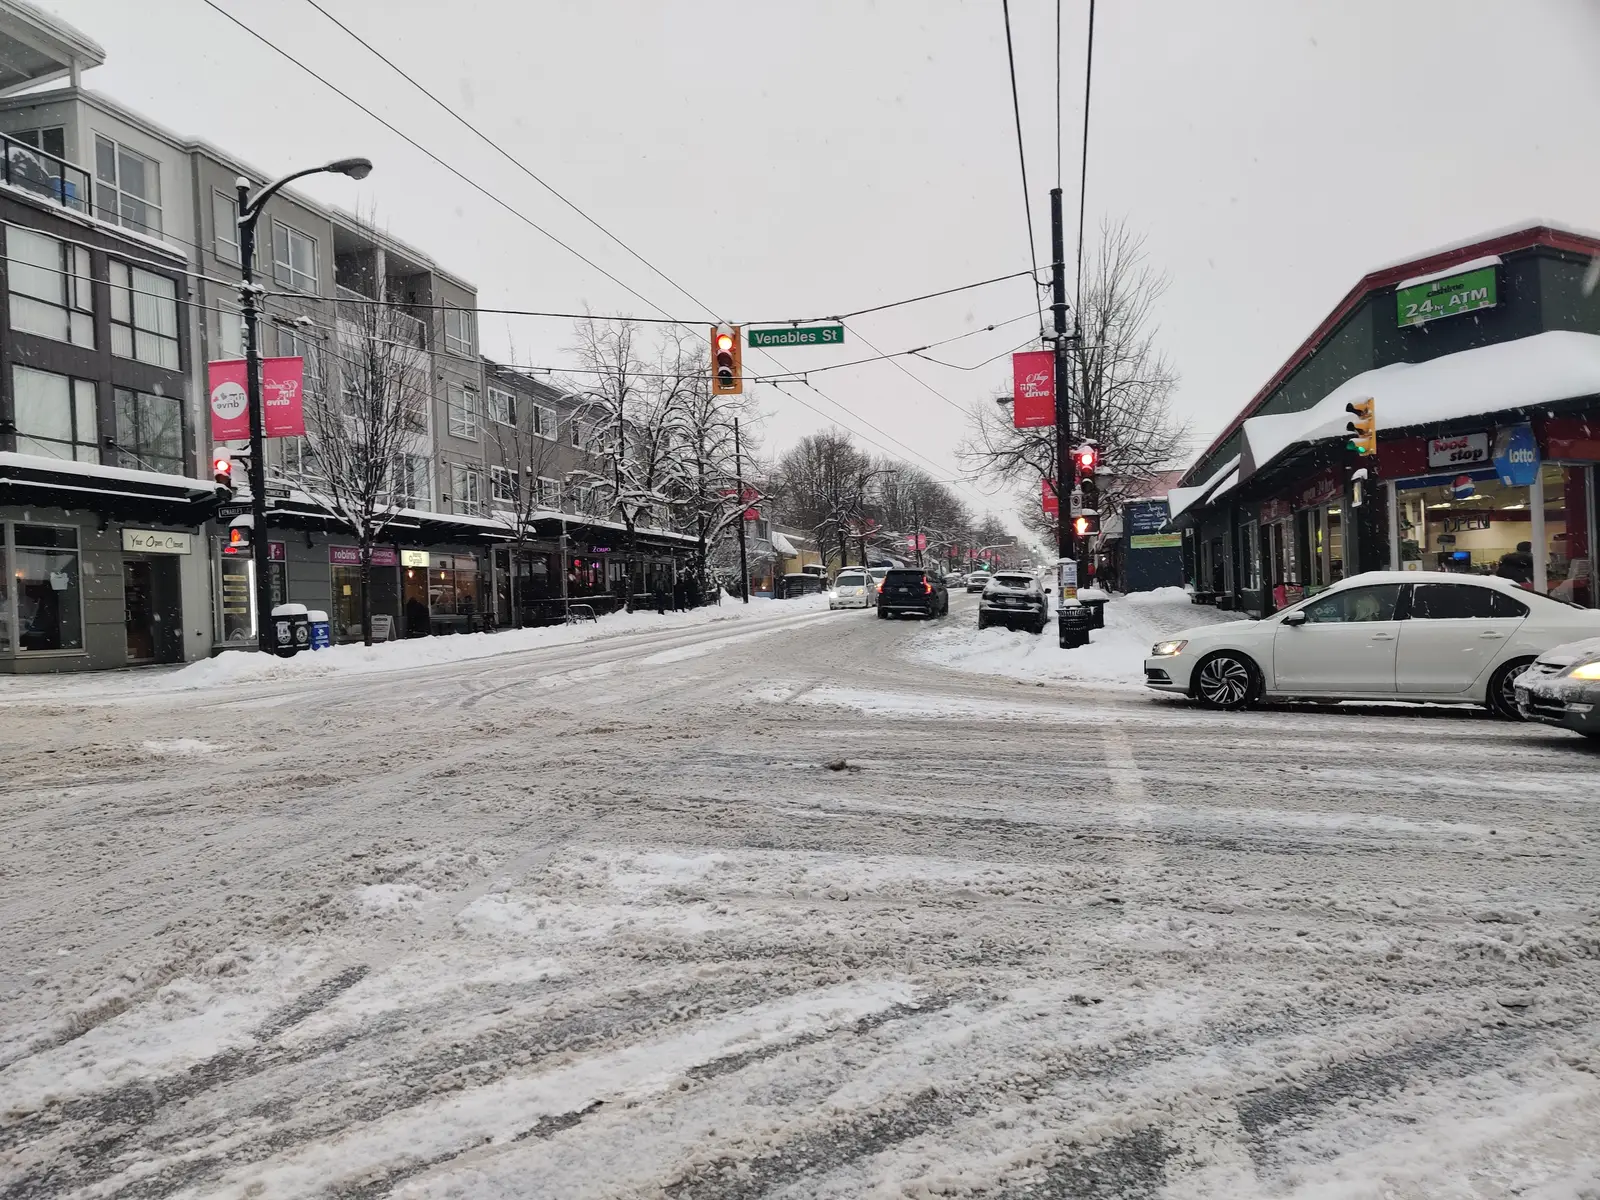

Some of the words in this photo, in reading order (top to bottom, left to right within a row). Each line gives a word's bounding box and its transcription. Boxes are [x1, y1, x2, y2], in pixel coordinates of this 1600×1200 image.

[1448, 287, 1488, 307] ATM
[754, 331, 816, 344] Venables
[822, 329, 837, 341] St
[1025, 388, 1050, 398] drive
[1433, 436, 1469, 453] food
[1449, 448, 1483, 462] stop
[129, 534, 143, 548] Your
[145, 535, 163, 548] Open
[165, 537, 184, 549] Closet
